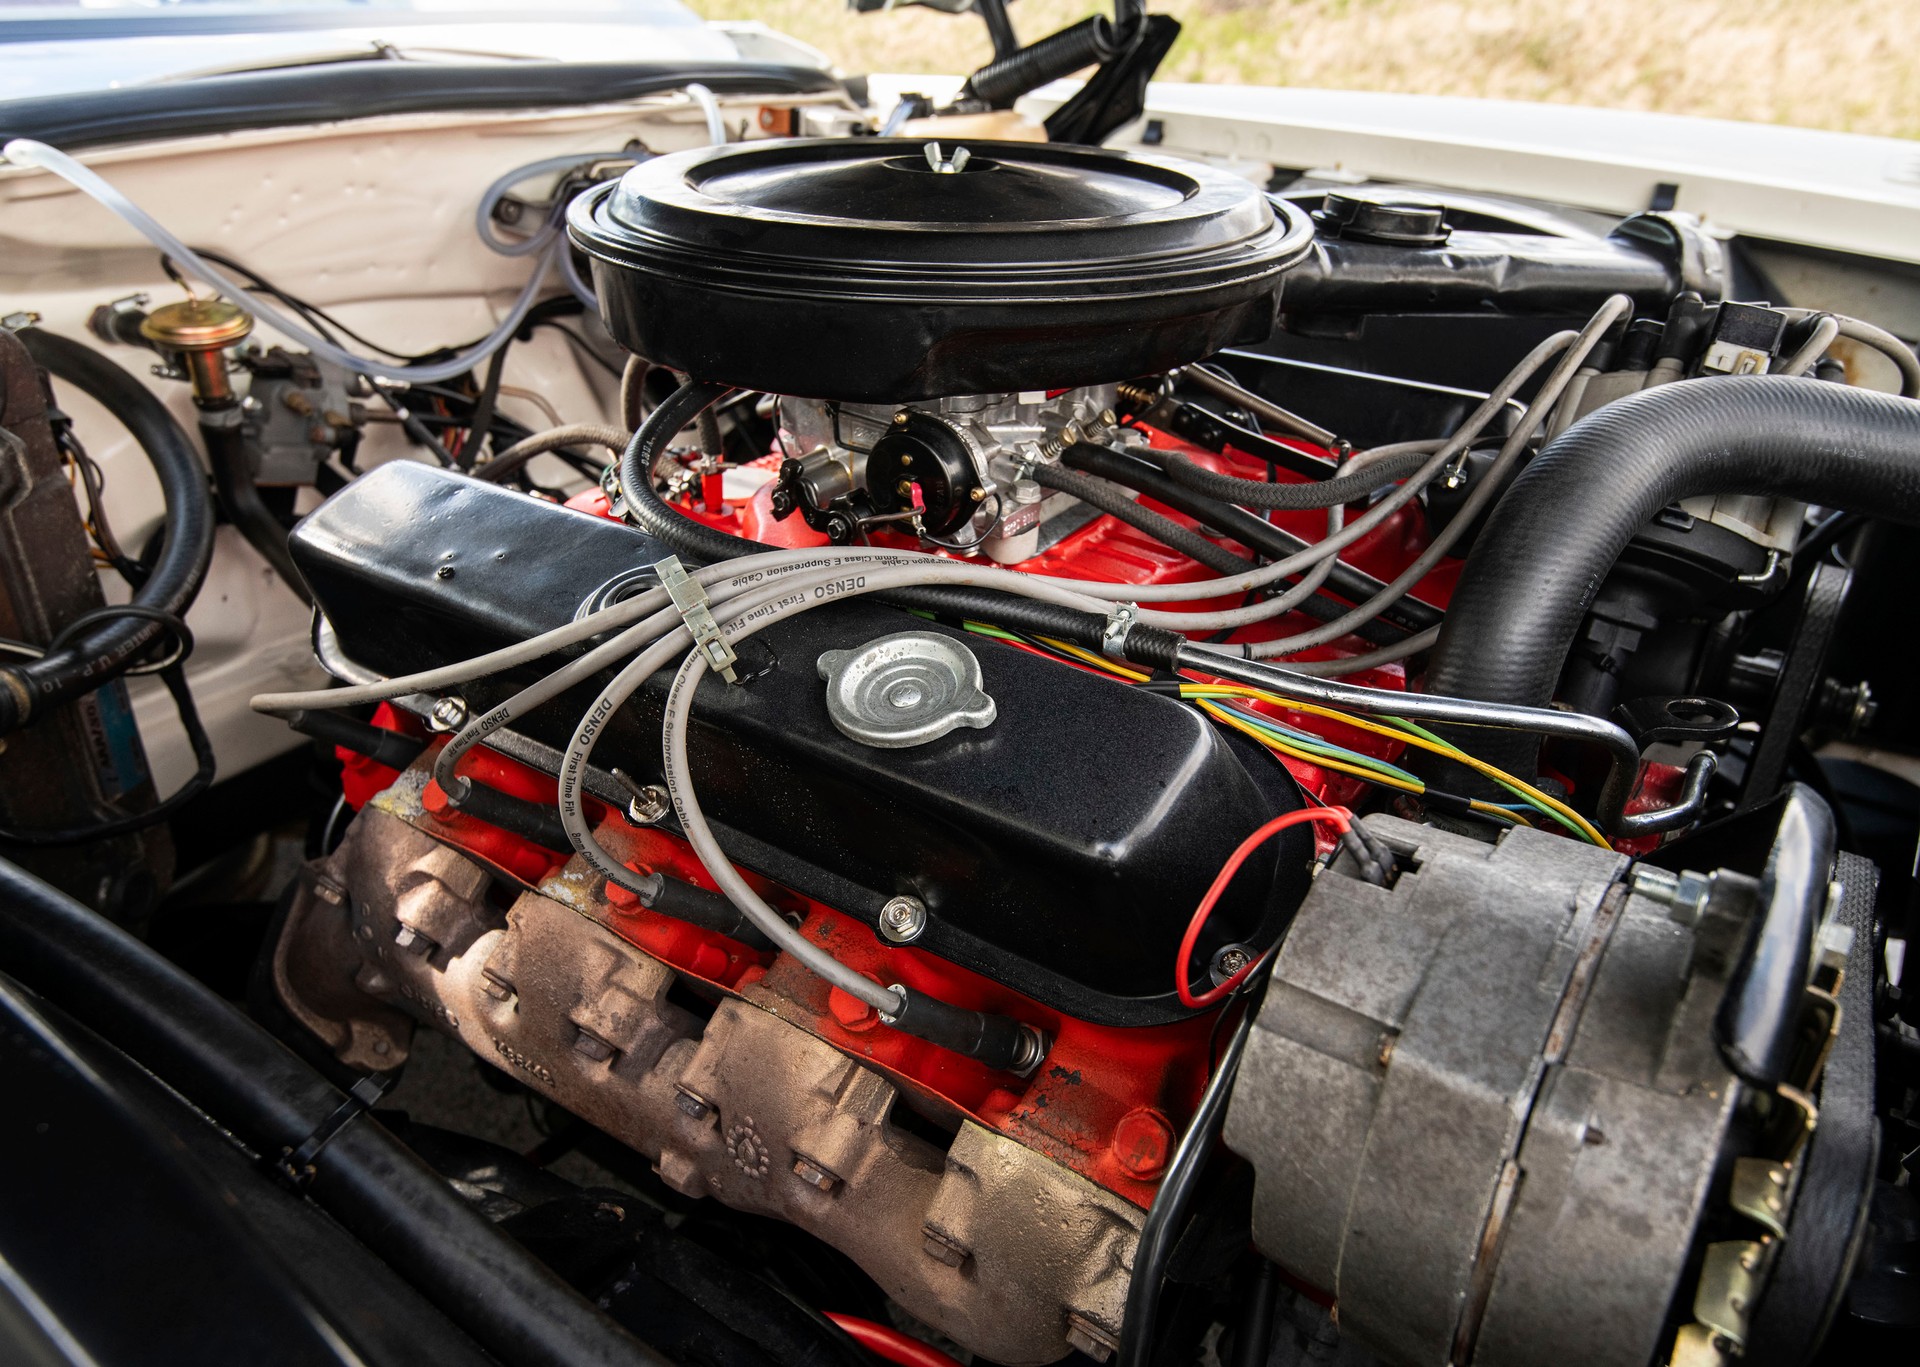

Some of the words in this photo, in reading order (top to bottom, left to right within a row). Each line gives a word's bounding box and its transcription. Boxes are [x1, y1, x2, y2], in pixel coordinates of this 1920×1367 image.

[766, 558, 831, 577] Suppression
[834, 557, 842, 566] E
[844, 555, 872, 564] Class
[731, 572, 763, 587] Cable
[813, 576, 866, 599] DENSO
[779, 593, 806, 610] First
[747, 603, 777, 621] Time
[668, 675, 686, 706] Class
[481, 707, 511, 731] DENSO
[578, 697, 613, 746] DENSO
[465, 727, 481, 741] First
[567, 751, 583, 773] First
[663, 721, 678, 793] Suppression
[564, 776, 577, 799] Time
[673, 797, 690, 829] Cable
[582, 851, 601, 869] Class
